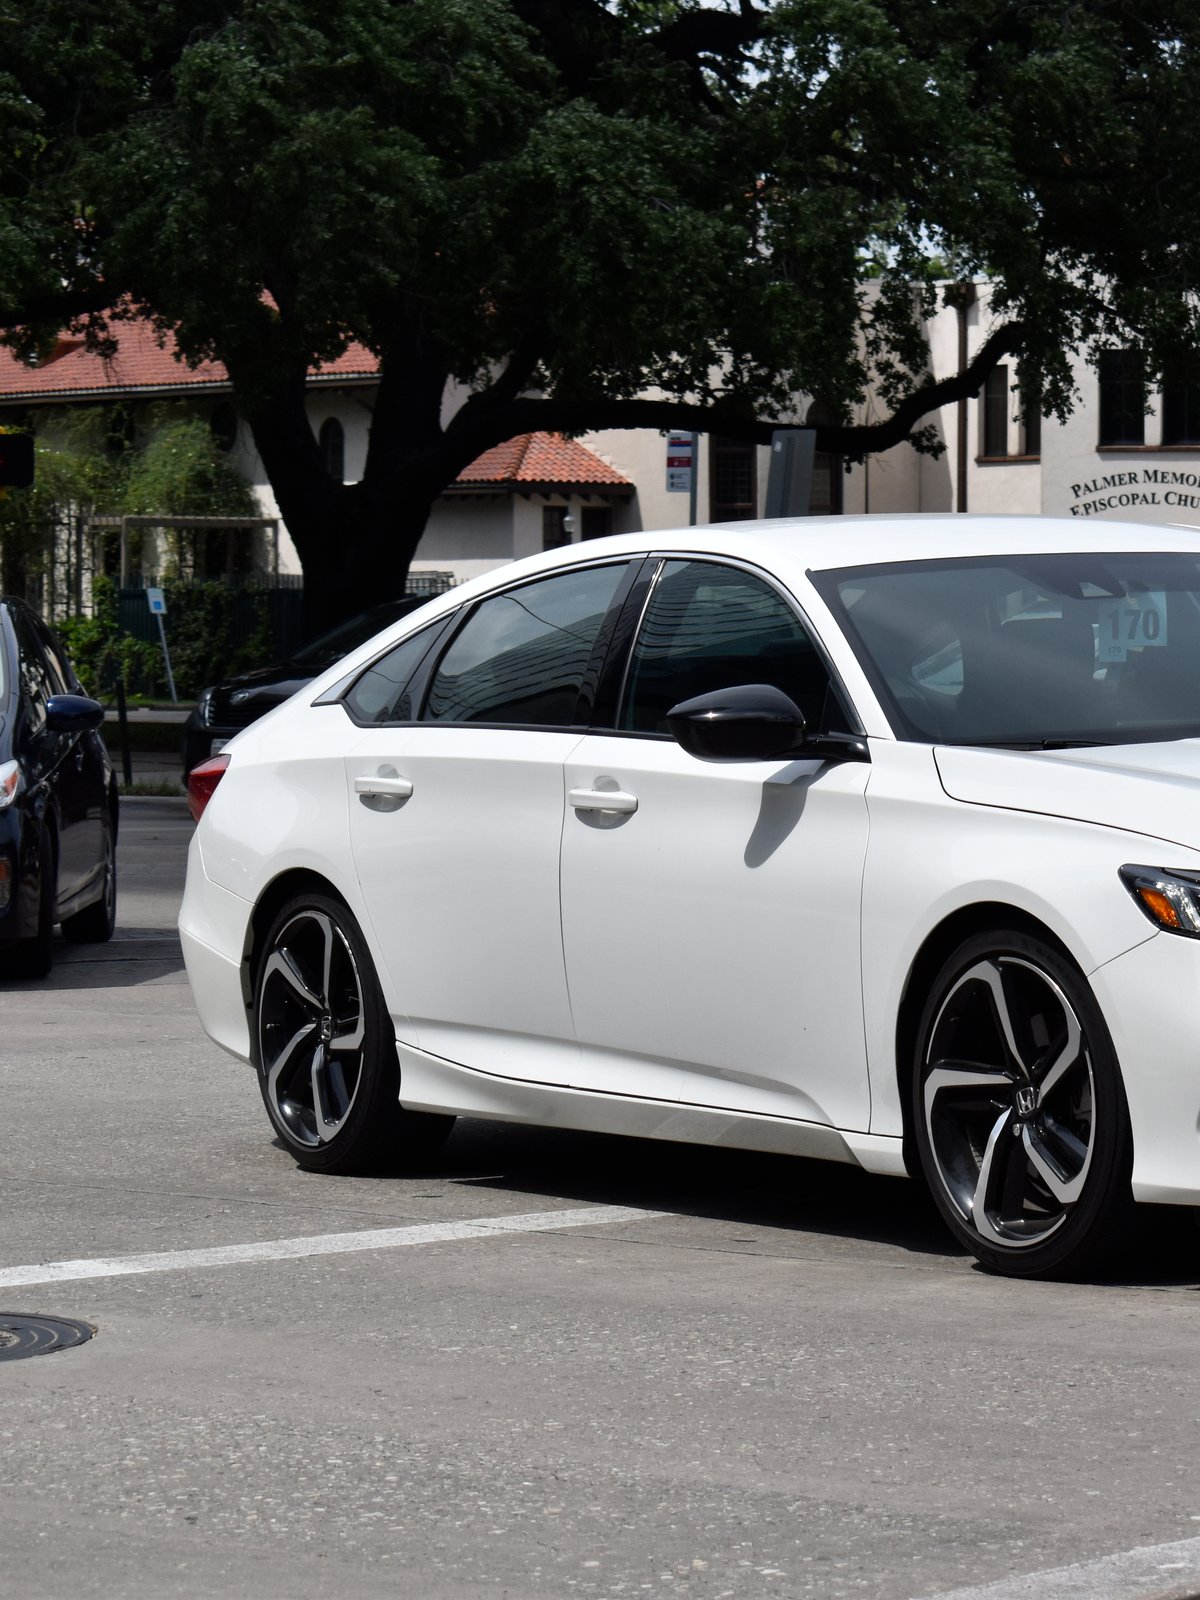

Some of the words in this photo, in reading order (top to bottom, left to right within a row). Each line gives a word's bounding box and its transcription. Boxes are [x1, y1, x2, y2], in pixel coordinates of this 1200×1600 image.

[1070, 472, 1139, 499] PALMER
[1070, 492, 1161, 517] EPISCOPAL
[1108, 608, 1161, 641] 170
